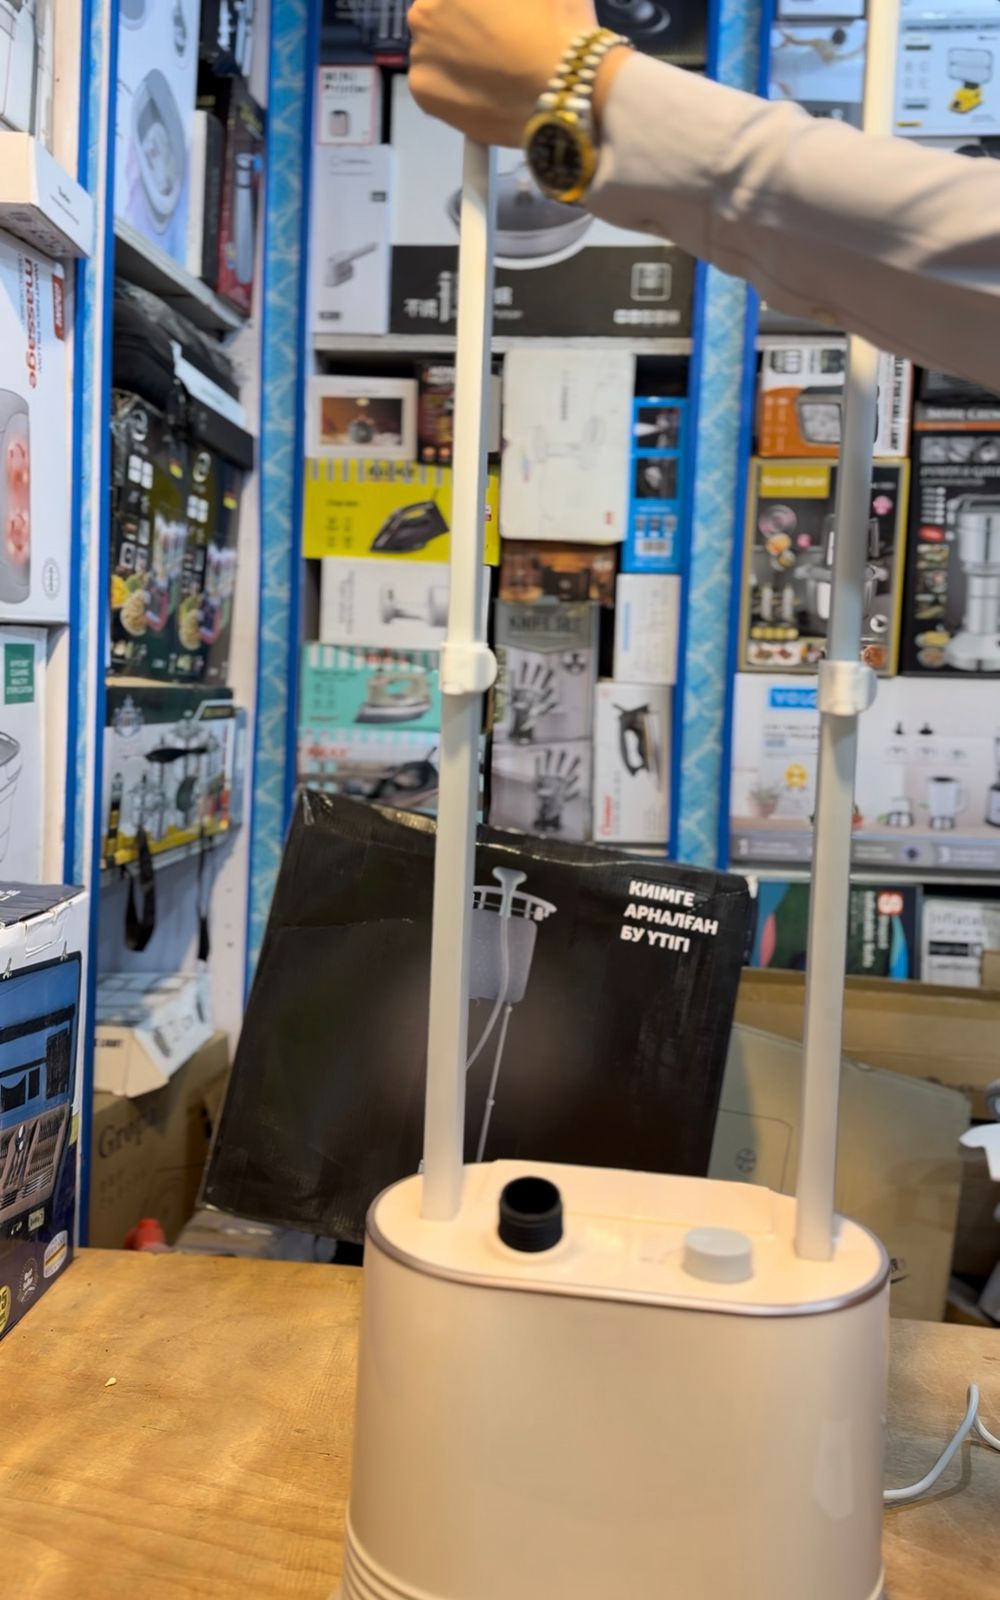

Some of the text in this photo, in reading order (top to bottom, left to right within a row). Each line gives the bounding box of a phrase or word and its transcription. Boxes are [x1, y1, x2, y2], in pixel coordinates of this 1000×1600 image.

[25, 257, 37, 389] massage
[628, 880, 696, 907] КИІМГЕ
[620, 924, 646, 943] БУ
[623, 903, 719, 935] АРНАЛҒАН
